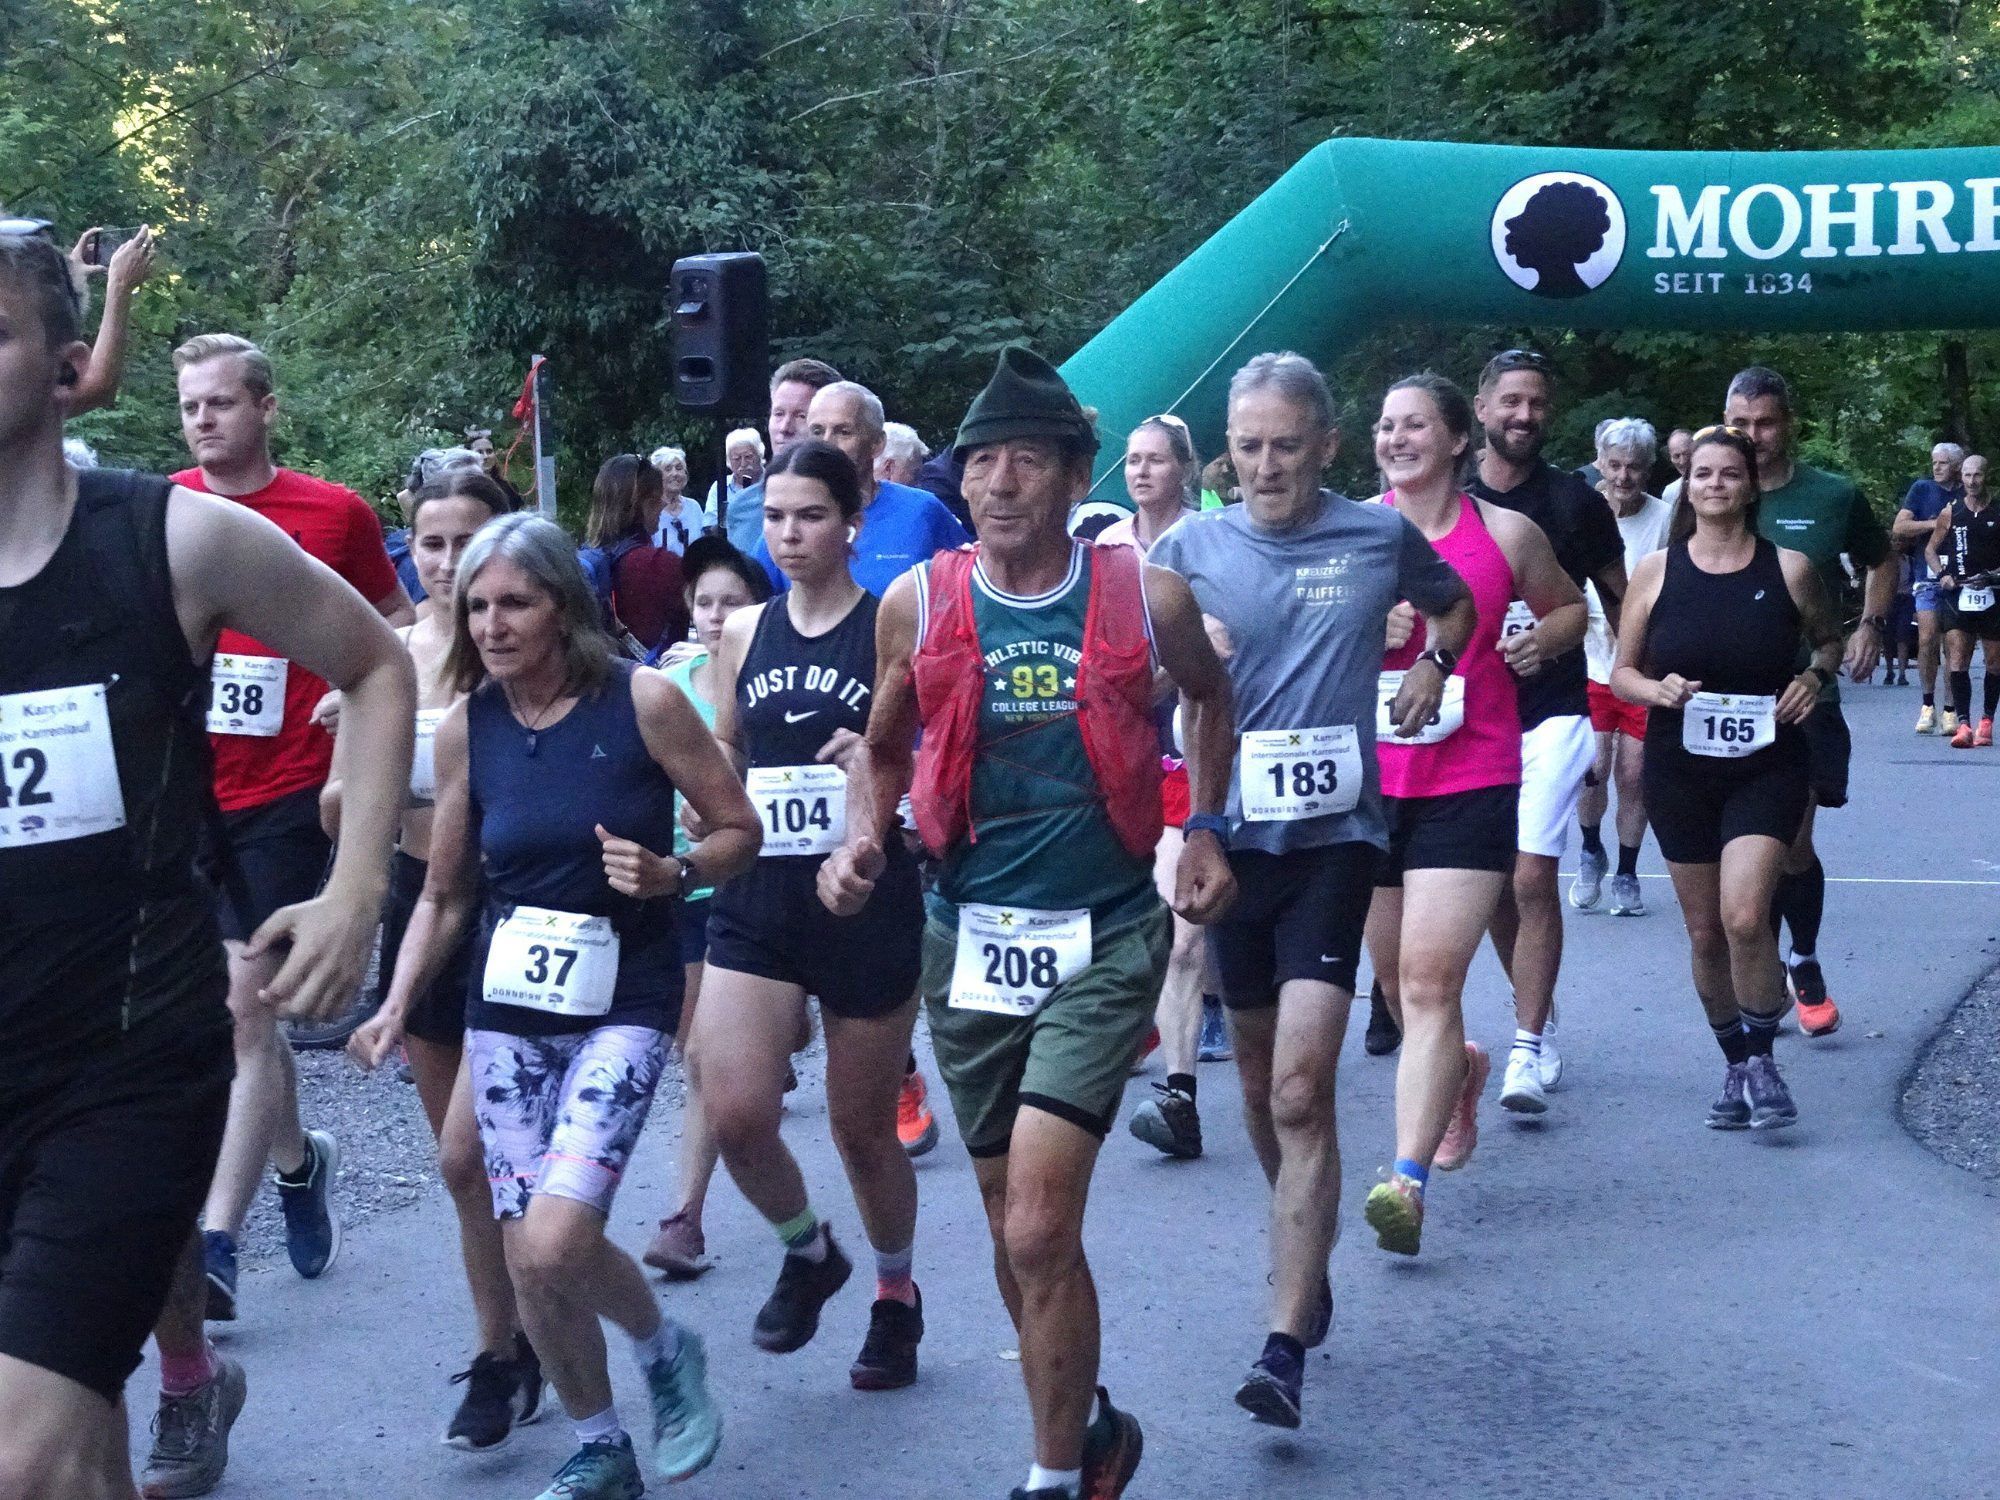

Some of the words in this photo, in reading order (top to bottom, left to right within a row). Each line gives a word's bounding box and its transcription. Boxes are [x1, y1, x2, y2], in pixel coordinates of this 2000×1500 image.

[1655, 272, 1725, 294] SEIT
[1745, 272, 1813, 294] 1834
[1967, 594, 1987, 606] 191
[746, 666, 798, 708] JUST
[804, 665, 838, 693] DO
[838, 677, 870, 712] IT.
[1012, 664, 1059, 698] 93
[992, 702, 1039, 713] COLLEGE
[1703, 715, 1755, 743] 165
[1268, 759, 1338, 798] 183
[766, 797, 832, 833] 104
[525, 944, 579, 988] 37
[983, 942, 1059, 989] 208
